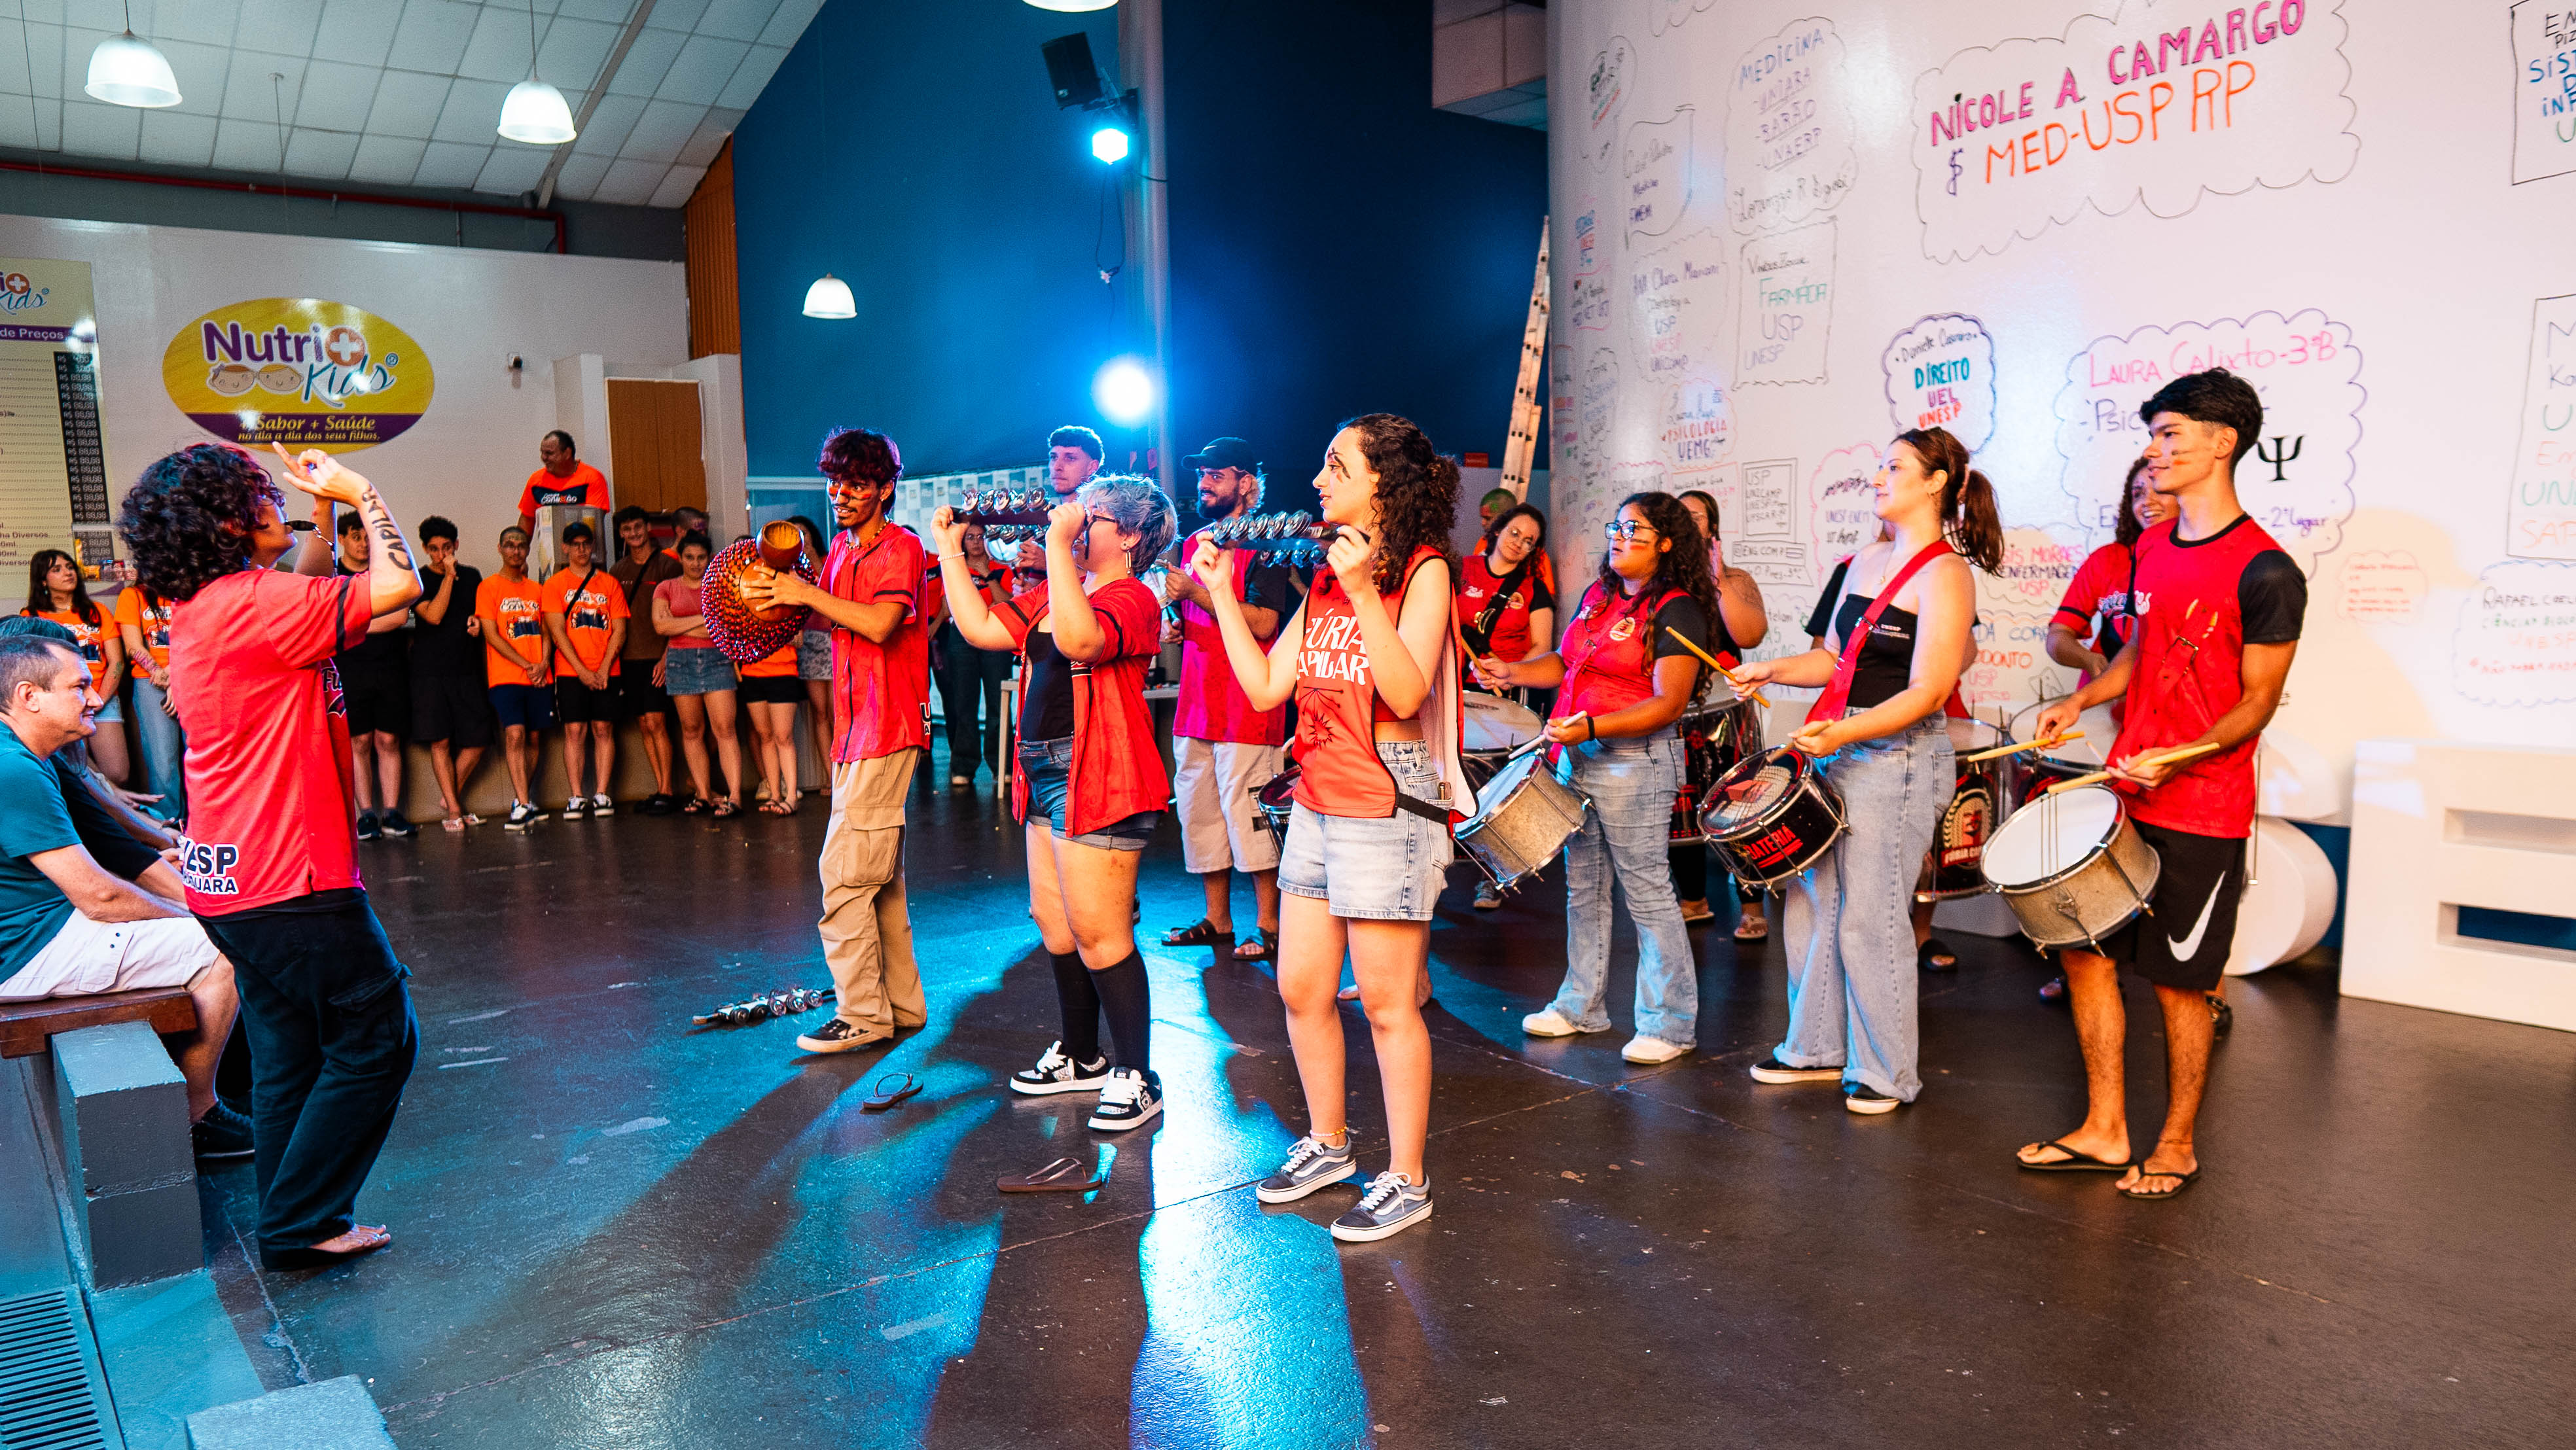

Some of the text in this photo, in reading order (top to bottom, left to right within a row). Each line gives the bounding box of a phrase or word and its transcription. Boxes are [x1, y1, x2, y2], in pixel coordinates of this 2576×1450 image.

[2055, 67, 2086, 109] A
[2109, 0, 2305, 85] CAMARGO
[1986, 60, 2256, 184] MED-USP RP
[19, 328, 64, 340] Preços
[1761, 313, 1804, 342] USP
[204, 323, 323, 362] Nutri
[1744, 344, 1785, 371] UNESP
[303, 353, 396, 408] Kids
[2090, 353, 2162, 387] LAURA
[1927, 387, 1959, 408] UEL
[257, 415, 306, 430] Sabor
[325, 415, 376, 430] Saúde
[1918, 401, 1962, 429] UNESP
[255, 431, 272, 440] dia
[285, 431, 302, 440] dia
[305, 431, 322, 440] dos
[1677, 438, 1710, 461] UEMG
[1747, 469, 1770, 486] USP
[2030, 544, 2085, 565] MORAES
[2018, 580, 2050, 597] USP
[2482, 586, 2539, 610] RAFAEL
[1296, 650, 1370, 686] APILAR
[1968, 668, 1998, 688] USP
